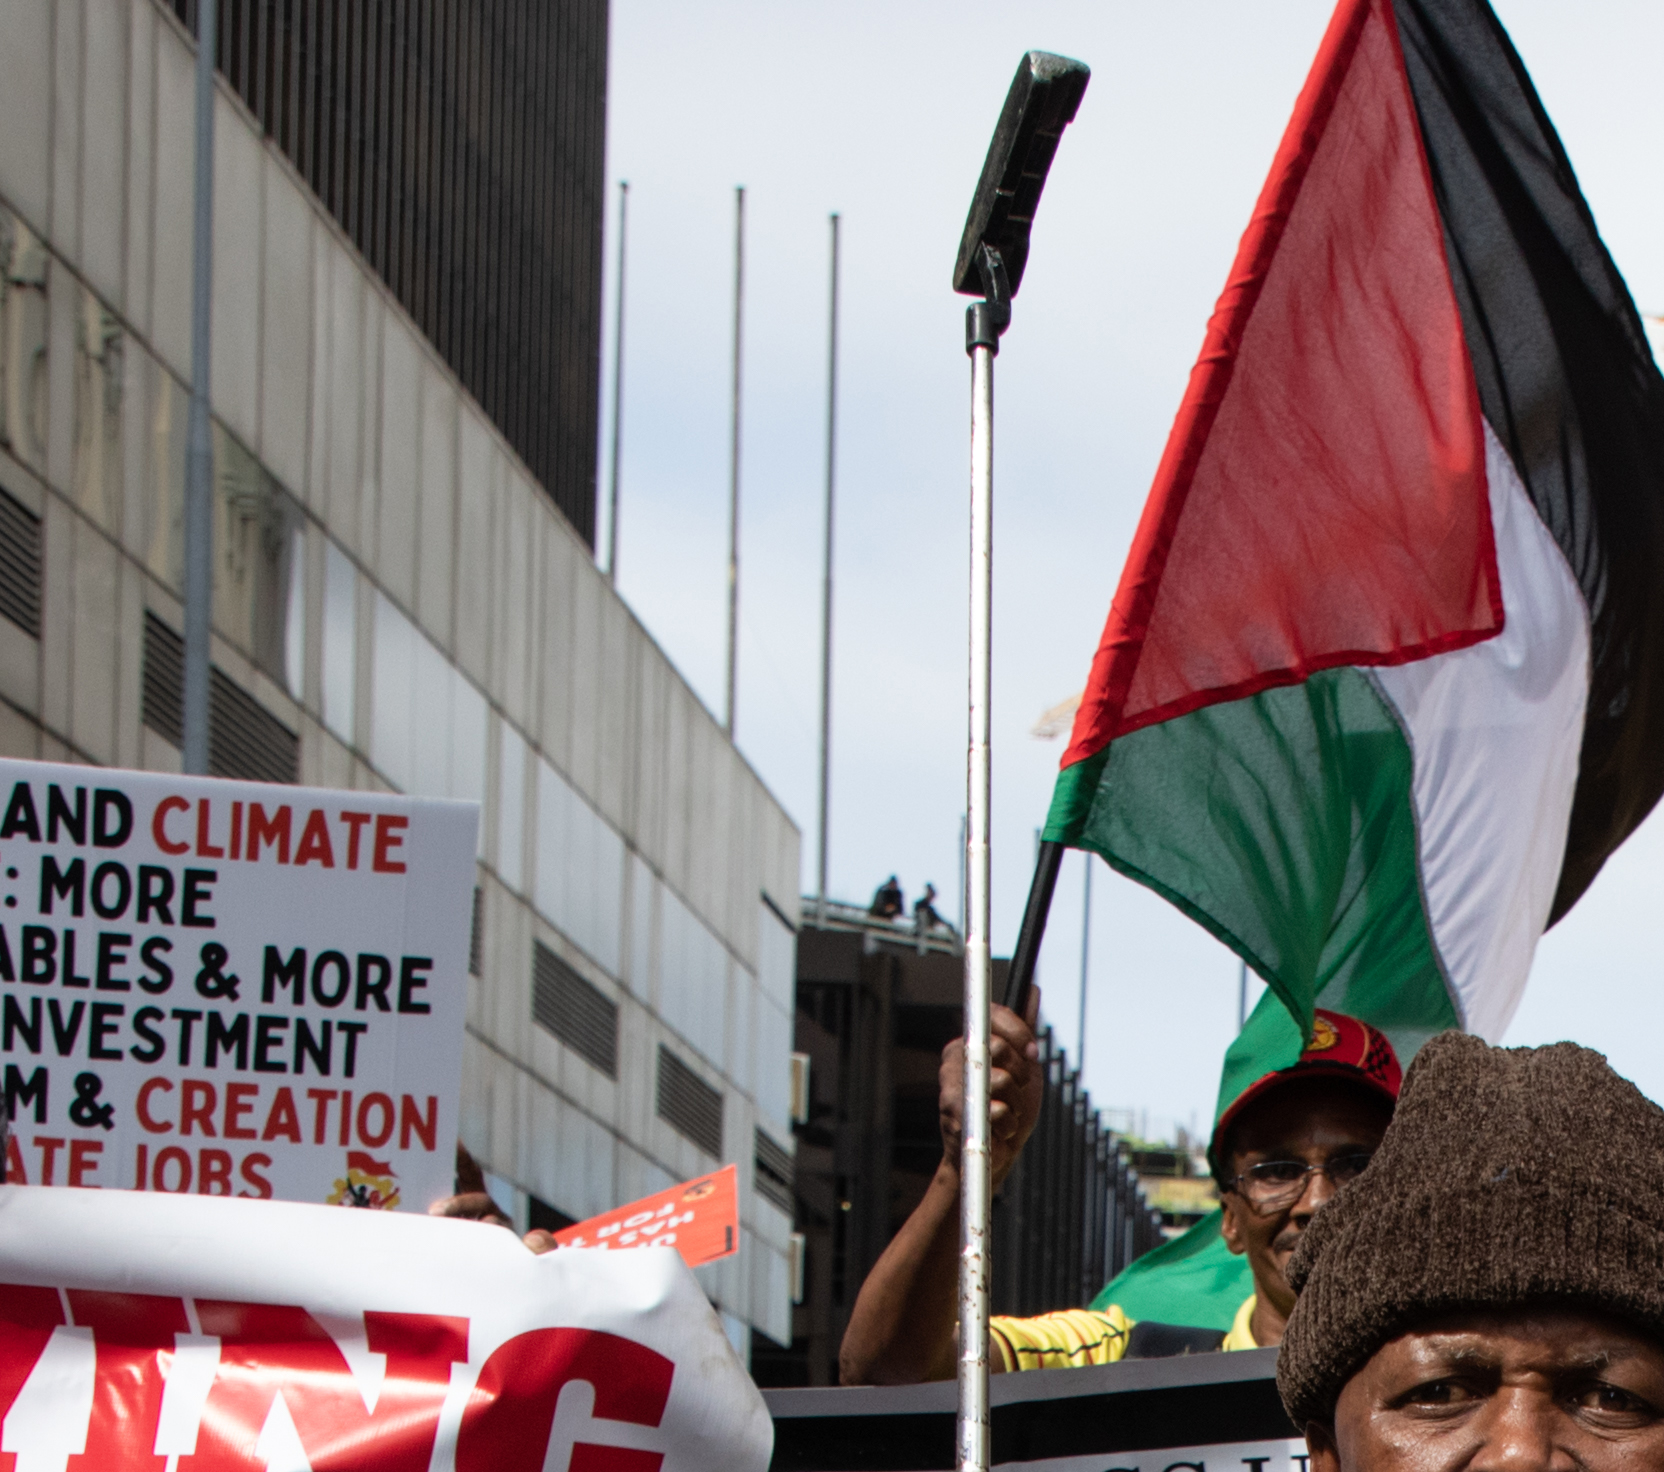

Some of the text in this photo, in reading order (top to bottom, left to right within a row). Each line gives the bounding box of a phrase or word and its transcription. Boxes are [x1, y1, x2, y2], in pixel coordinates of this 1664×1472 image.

[152, 796, 409, 874] CLIMATE
[38, 856, 219, 928] MORE
[195, 942, 240, 1002] &
[260, 944, 433, 1014] MORE
[69, 1072, 115, 1130] &
[136, 1076, 438, 1152] CREATION
[132, 1143, 273, 1200] JOBS
